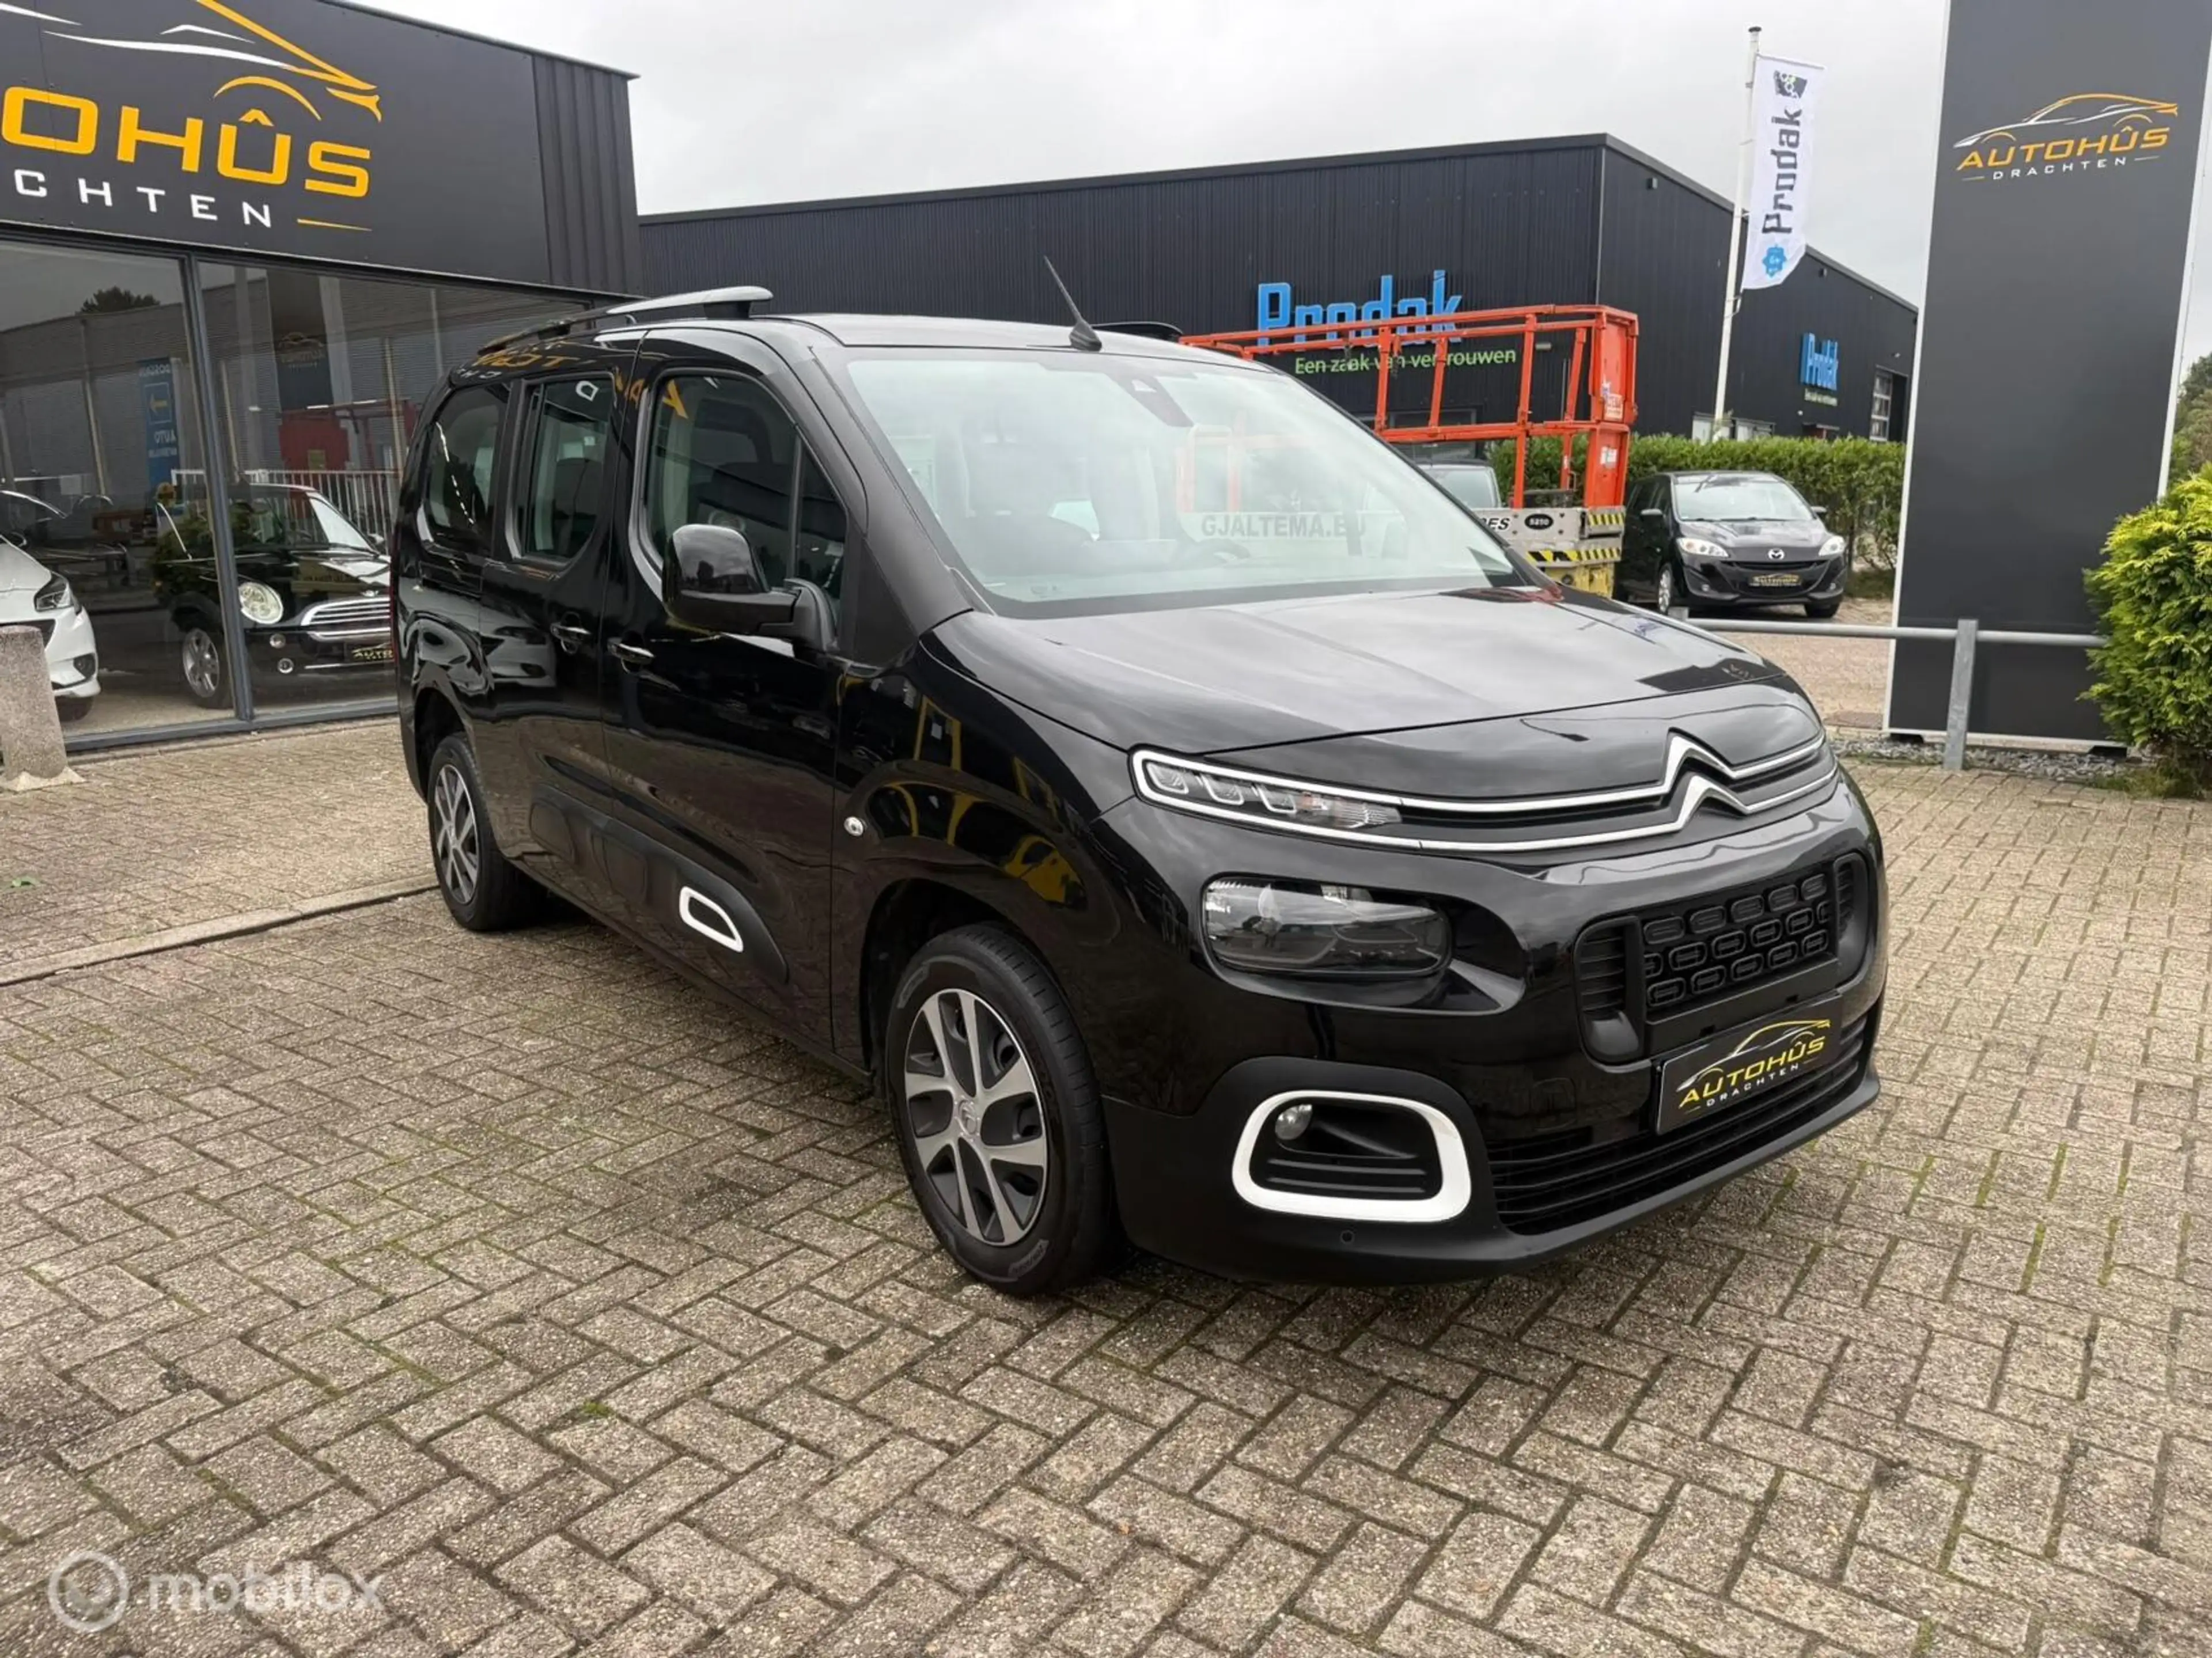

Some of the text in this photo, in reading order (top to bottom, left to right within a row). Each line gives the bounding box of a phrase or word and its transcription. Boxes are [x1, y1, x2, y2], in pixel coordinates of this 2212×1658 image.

[1762, 108, 1802, 234] Prodak
[1956, 126, 2171, 171] AUTOHÛS
[1993, 157, 2127, 180] DRACHTEN
[1258, 269, 1463, 354] Prodak
[1295, 357, 1326, 374] Een
[1410, 349, 1516, 368] verrouwen
[1679, 1036, 1825, 1109] AUTOHÛS
[1706, 1063, 1799, 1107] DRACHTEN
